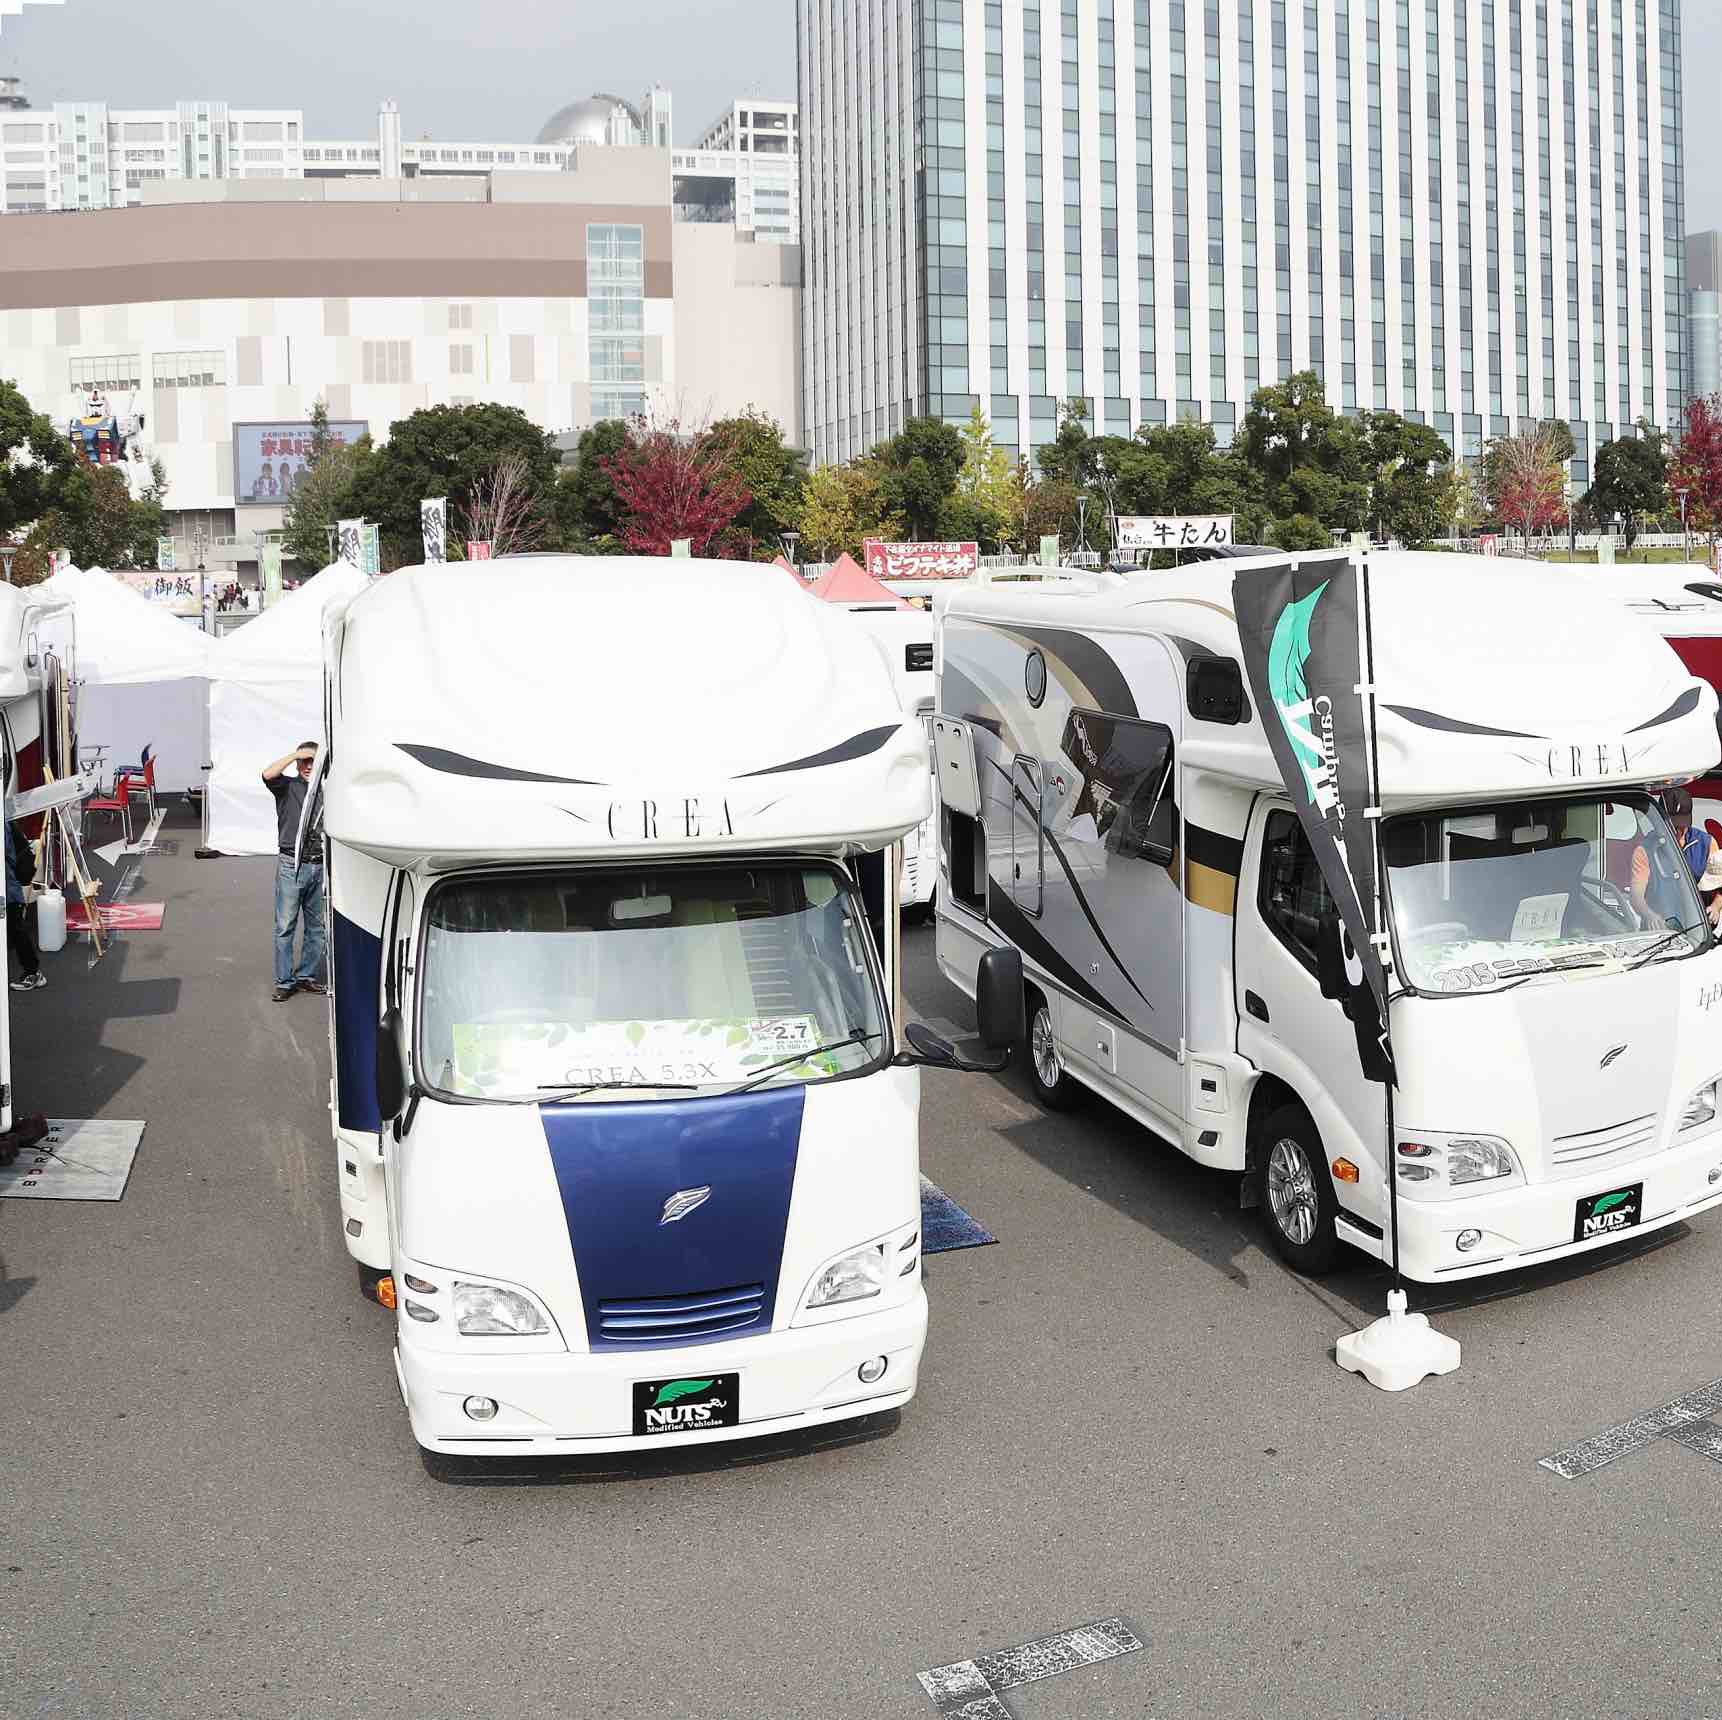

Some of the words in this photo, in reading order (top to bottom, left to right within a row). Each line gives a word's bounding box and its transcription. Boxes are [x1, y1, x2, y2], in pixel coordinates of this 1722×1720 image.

[1153, 520, 1226, 545] 牛たん
[155, 576, 193, 597] 御飯
[1548, 743, 1630, 777] CREA
[607, 797, 735, 840] CREA
[774, 1026, 807, 1040] 2.7
[565, 1064, 652, 1086] CREA
[661, 1062, 720, 1081] 5.3X
[1583, 1210, 1626, 1235] NUTS
[645, 1404, 712, 1427] NUTS
[647, 1422, 684, 1434] Modified
[686, 1418, 724, 1430] Vehicles
